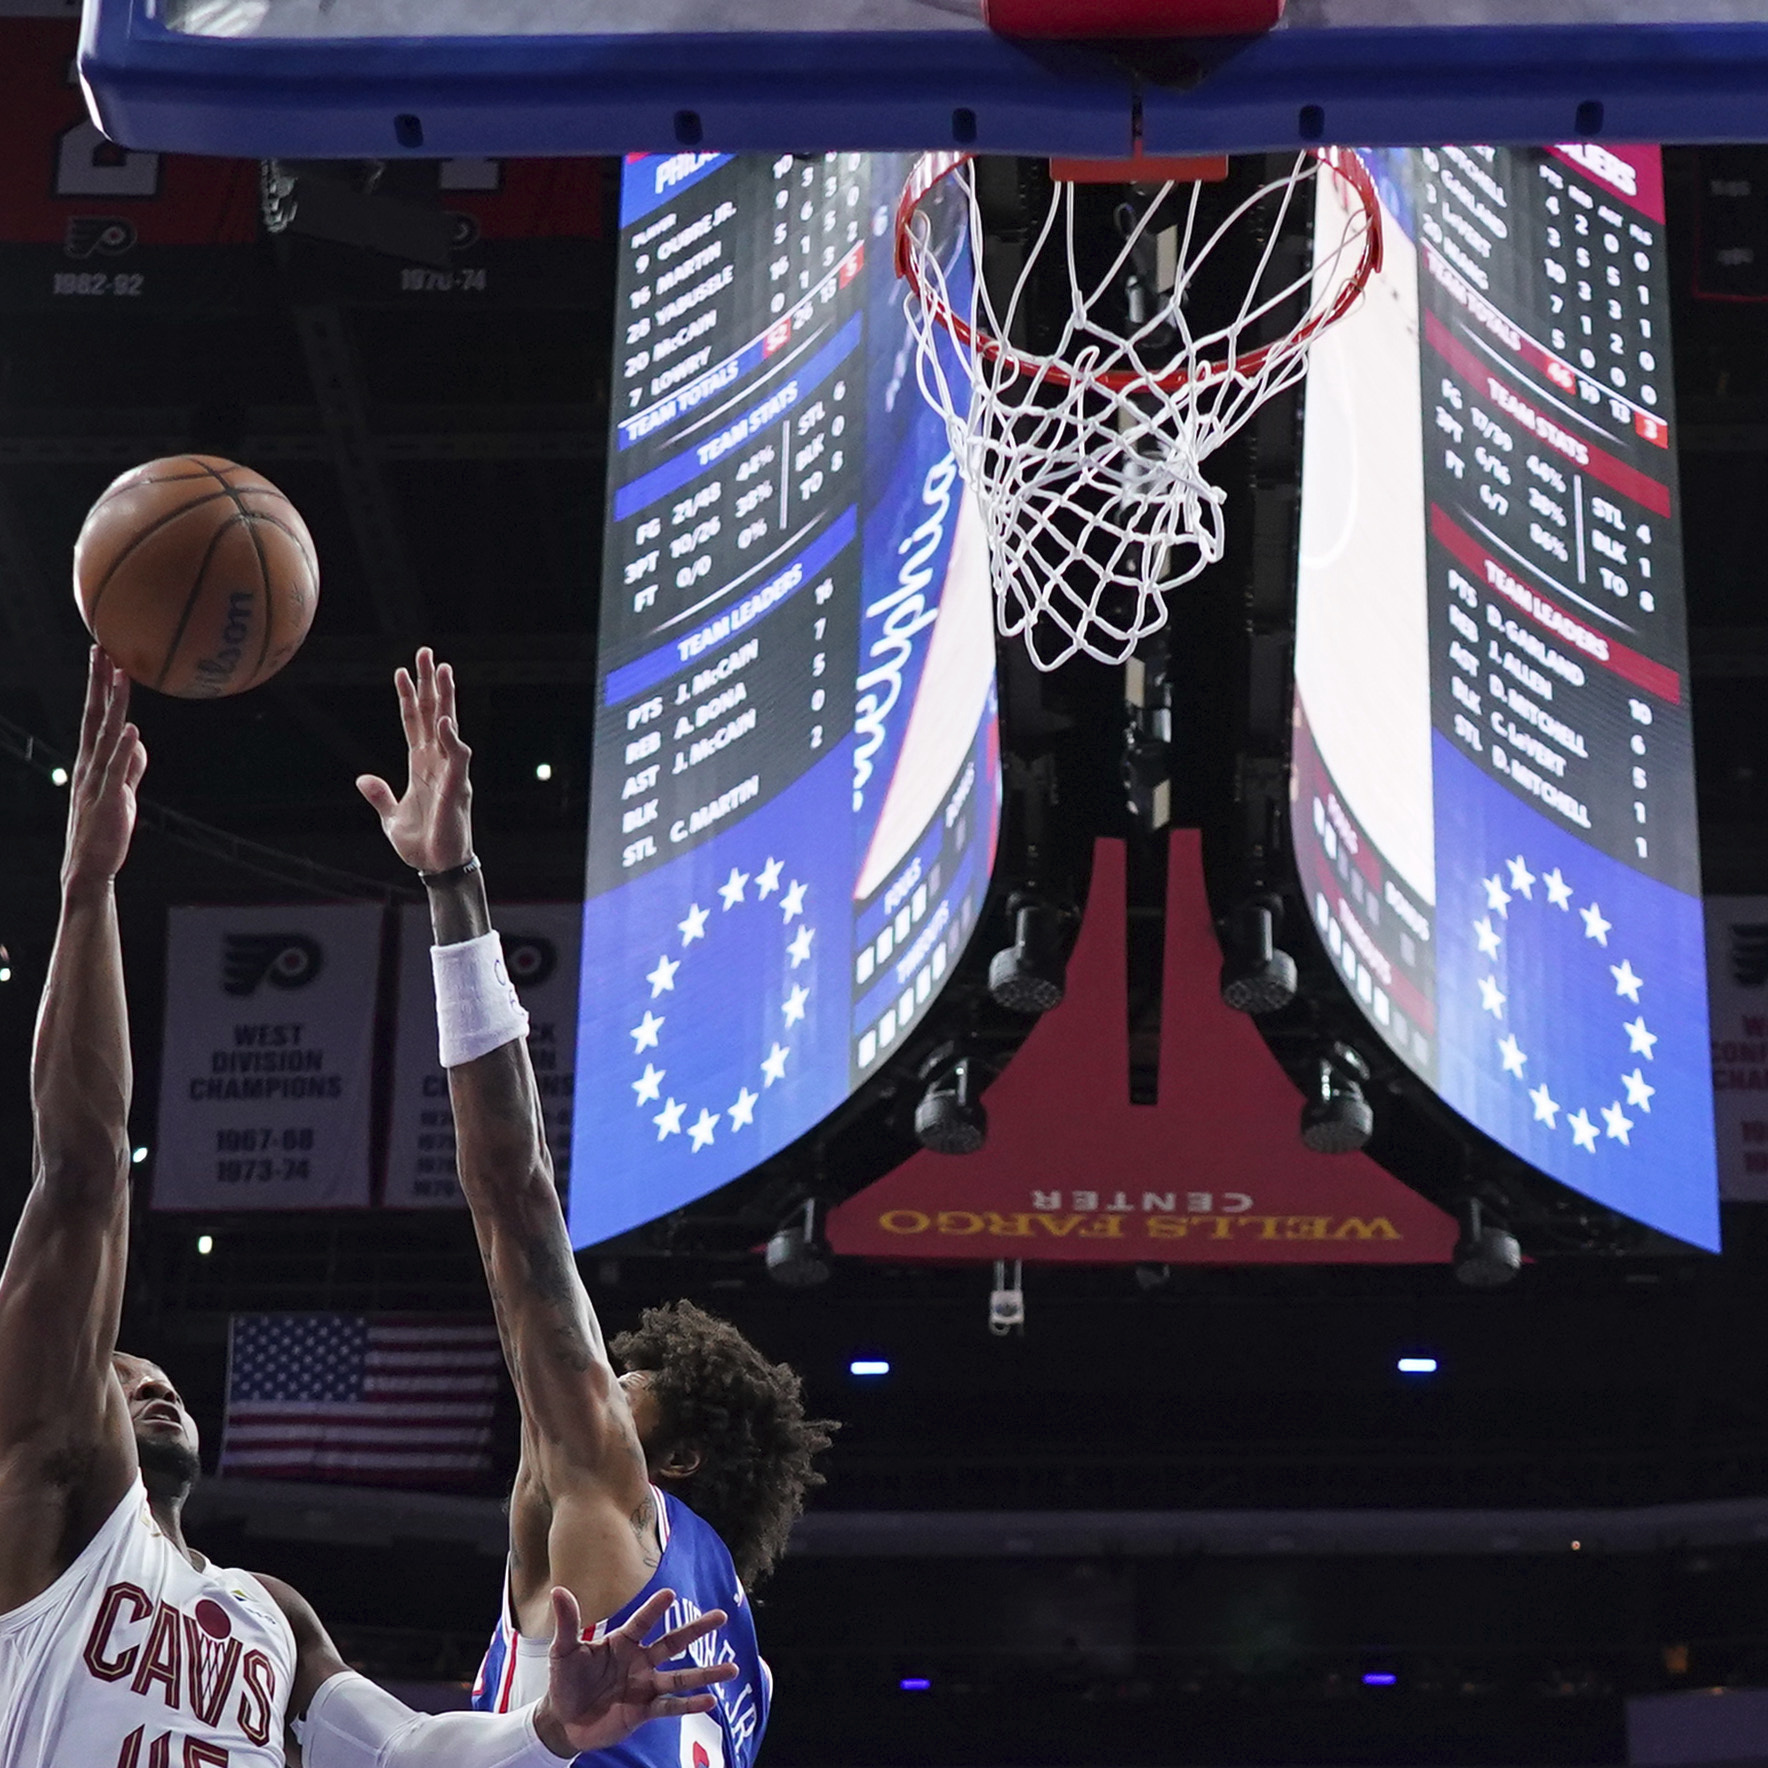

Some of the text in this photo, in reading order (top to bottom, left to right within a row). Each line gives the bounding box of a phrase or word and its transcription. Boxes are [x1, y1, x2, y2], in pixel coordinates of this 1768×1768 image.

[1604, 233, 1619, 253] 0
[1634, 251, 1650, 272] 0
[1637, 285, 1649, 305] 1
[1580, 315, 1655, 372] 1 2 0
[1640, 318, 1651, 338] 1
[1580, 348, 1596, 369] 0
[1610, 367, 1627, 387] 0
[1641, 384, 1657, 405] 0
[626, 360, 739, 441] TEAM TOTALS
[696, 380, 798, 466] TEAM STATS
[1487, 377, 1536, 430] TEAM
[1536, 416, 1589, 465] STATS
[634, 584, 659, 613] FT
[676, 555, 712, 588] 0/0
[1599, 566, 1629, 597] TO
[1639, 557, 1651, 578] 1
[678, 563, 803, 662] TEAM LEADERS
[1484, 559, 1610, 661] TEAM LEADERS
[627, 697, 663, 730] PTS
[625, 731, 662, 765] REB
[622, 764, 660, 800] AST
[1632, 766, 1647, 789] 5
[622, 835, 657, 868] STL
[689, 775, 760, 833] MARTIN
[623, 799, 659, 833] BLK
[1634, 801, 1646, 823] 1
[1635, 836, 1648, 858] 1
[234, 1024, 304, 1046] WEST
[211, 1050, 324, 1072] DIVISION
[189, 1076, 342, 1100] CHAMPIONS
[1031, 1191, 1254, 1214] CENTER
[878, 1210, 1403, 1240] WELLS FARGO
[83, 1581, 277, 1747] CAVS
